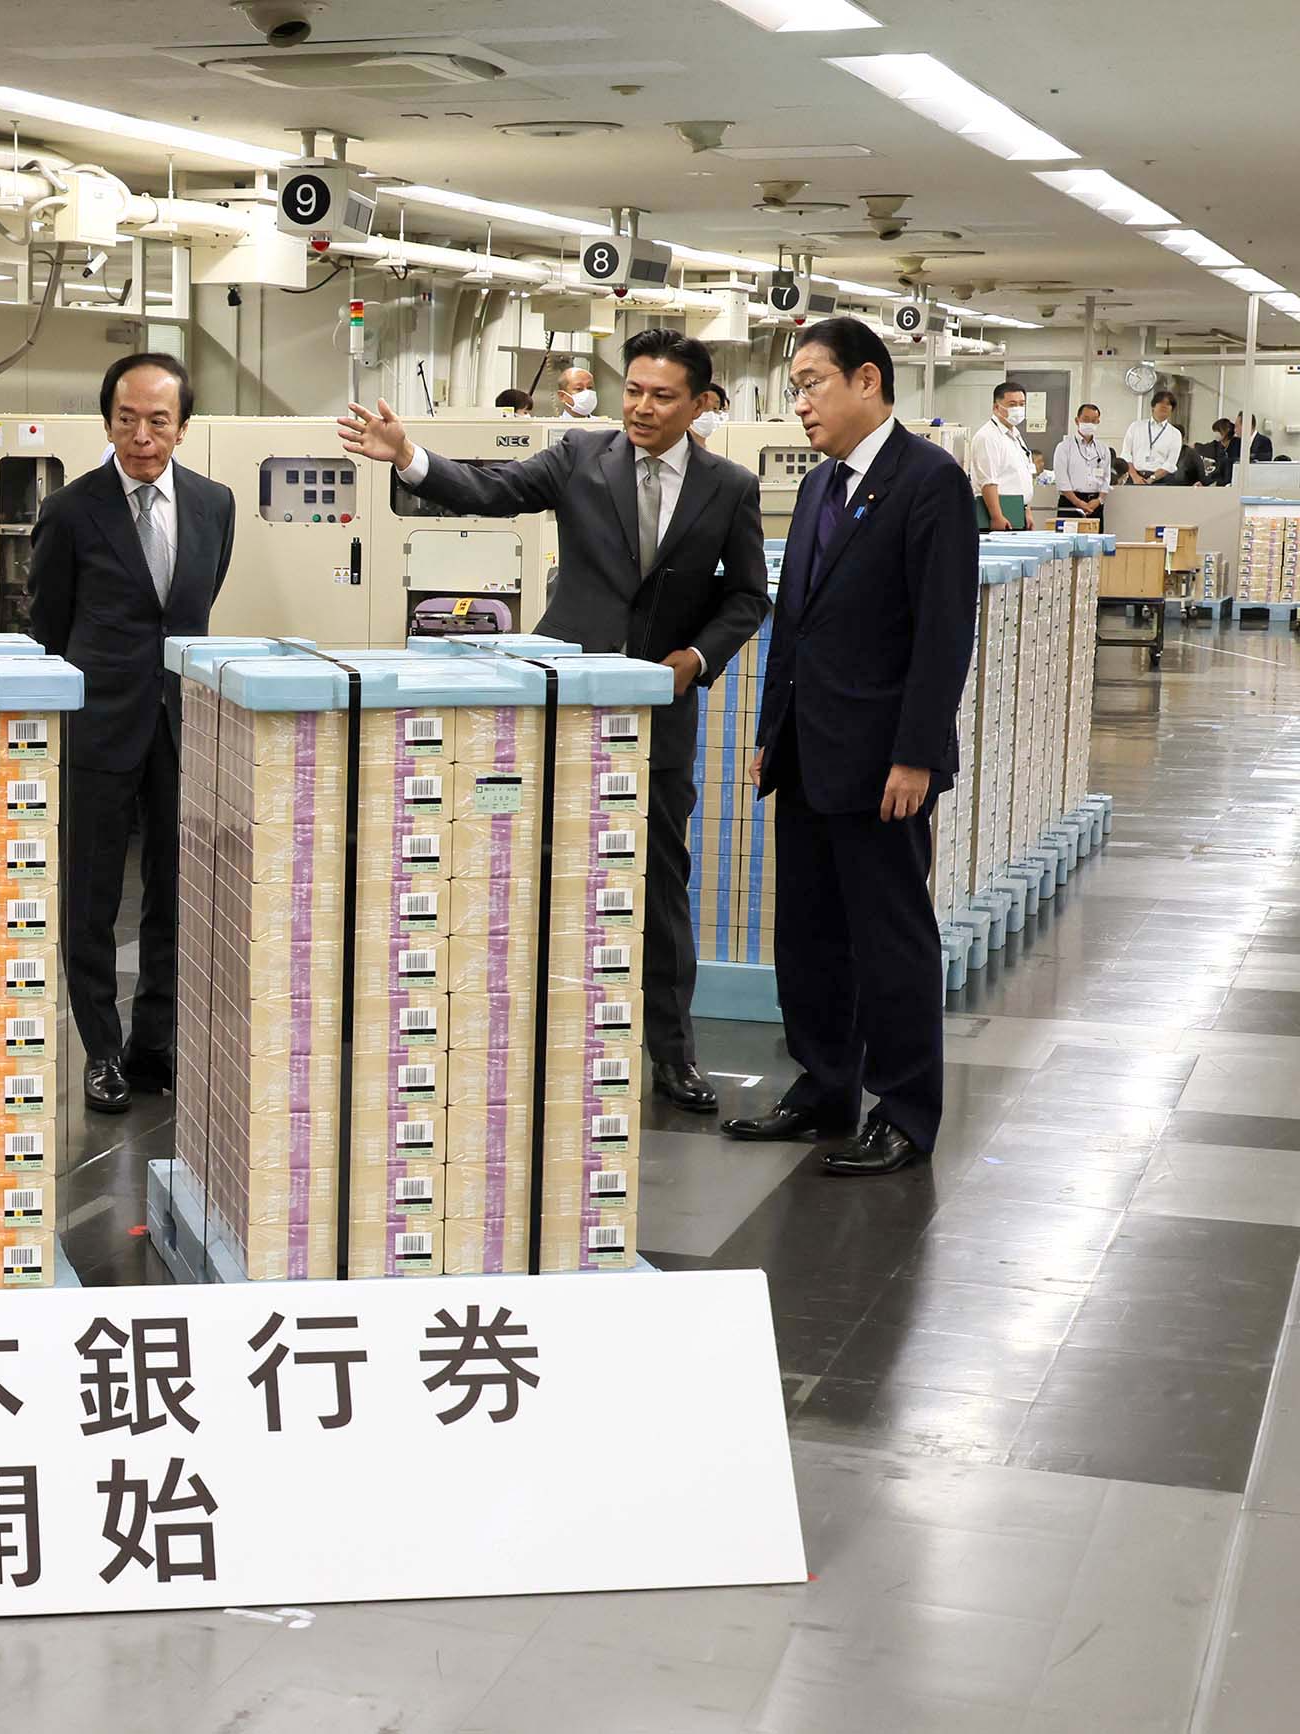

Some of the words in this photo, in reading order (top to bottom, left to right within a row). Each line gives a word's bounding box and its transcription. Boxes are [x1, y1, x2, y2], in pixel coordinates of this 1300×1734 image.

[296, 184, 317, 216] 9
[593, 248, 609, 273] 8
[779, 287, 791, 306] 7
[902, 310, 914, 327] 6
[496, 435, 530, 447] NEC
